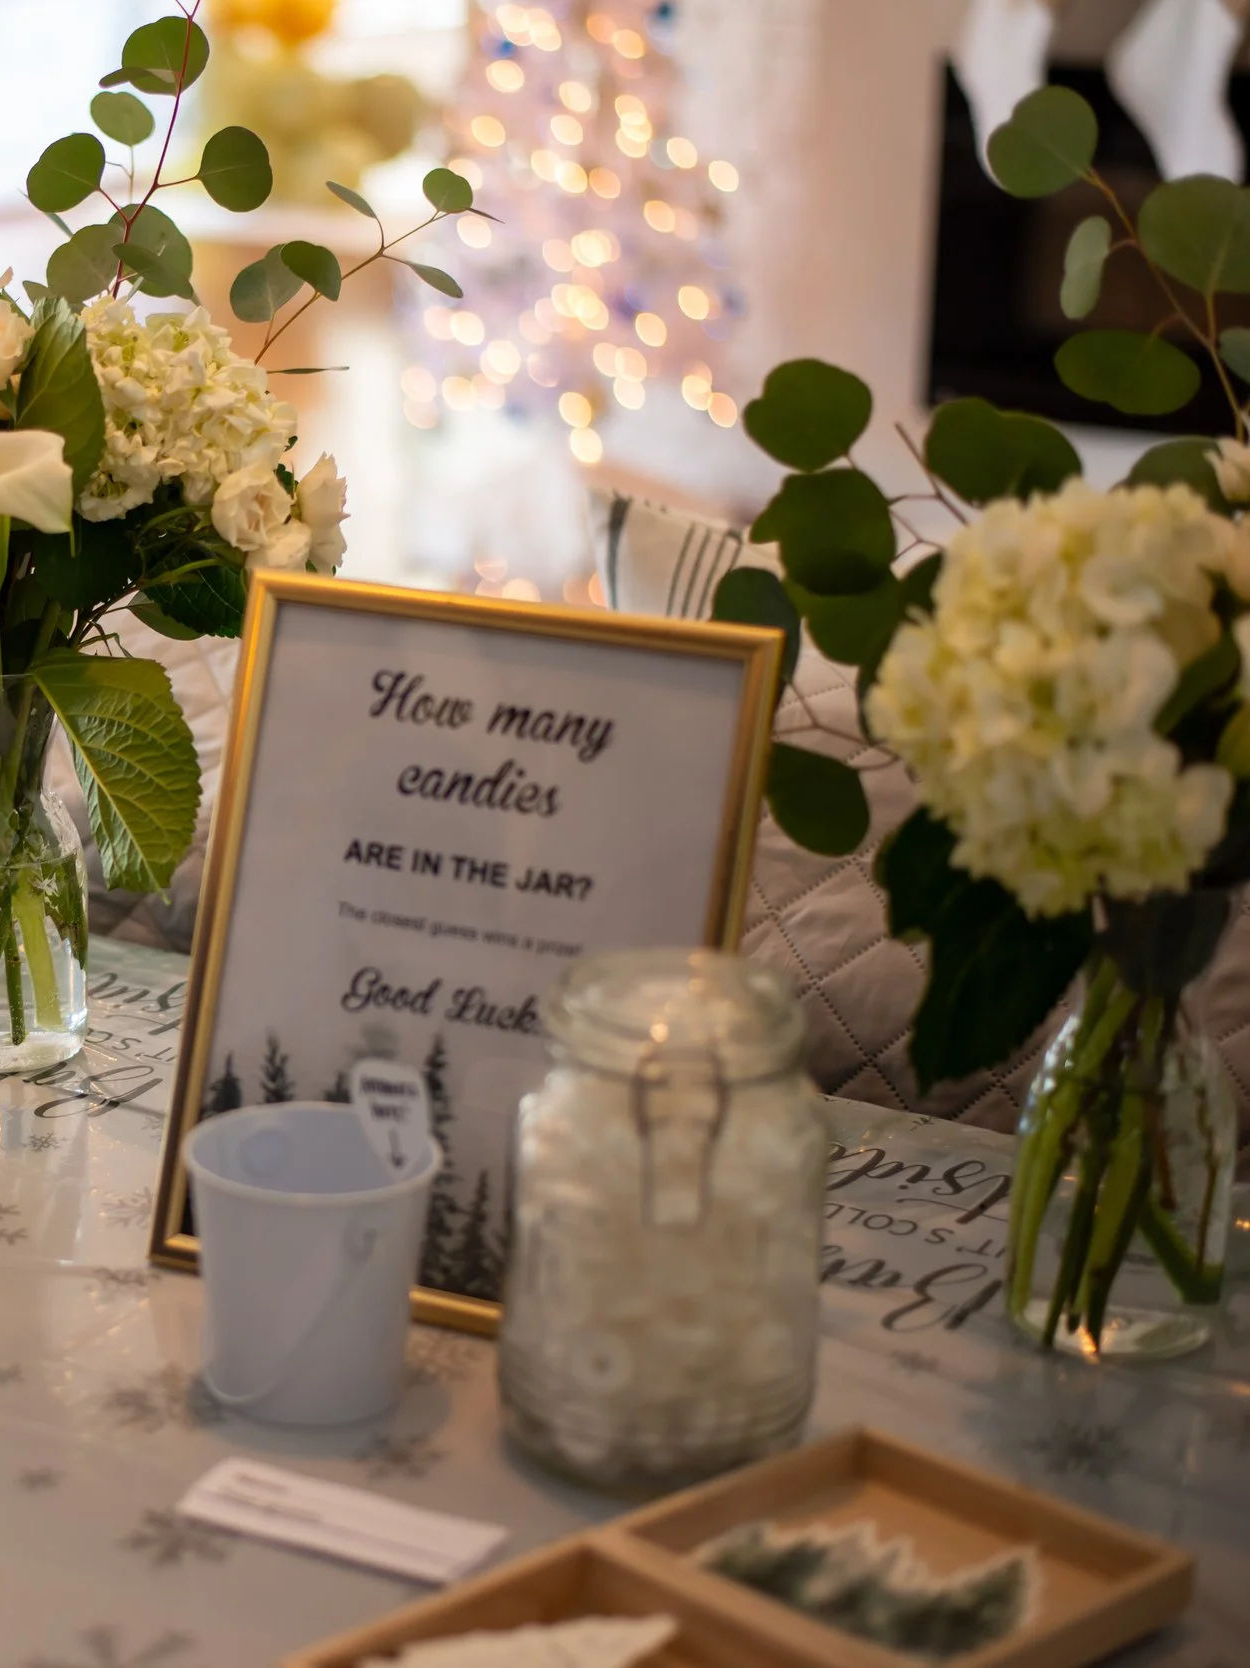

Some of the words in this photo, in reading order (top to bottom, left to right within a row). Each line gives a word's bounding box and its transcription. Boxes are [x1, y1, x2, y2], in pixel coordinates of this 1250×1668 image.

[368, 668, 475, 730] How
[485, 703, 616, 765] many
[396, 757, 562, 819] candies
[343, 838, 405, 871] ARE
[410, 847, 444, 877] IN
[451, 854, 510, 889] THE
[515, 865, 596, 902] JAR?
[337, 900, 368, 922] The
[370, 908, 427, 932] closest
[429, 918, 479, 939] guess
[481, 929, 518, 948] wins
[340, 966, 444, 1017] Good
